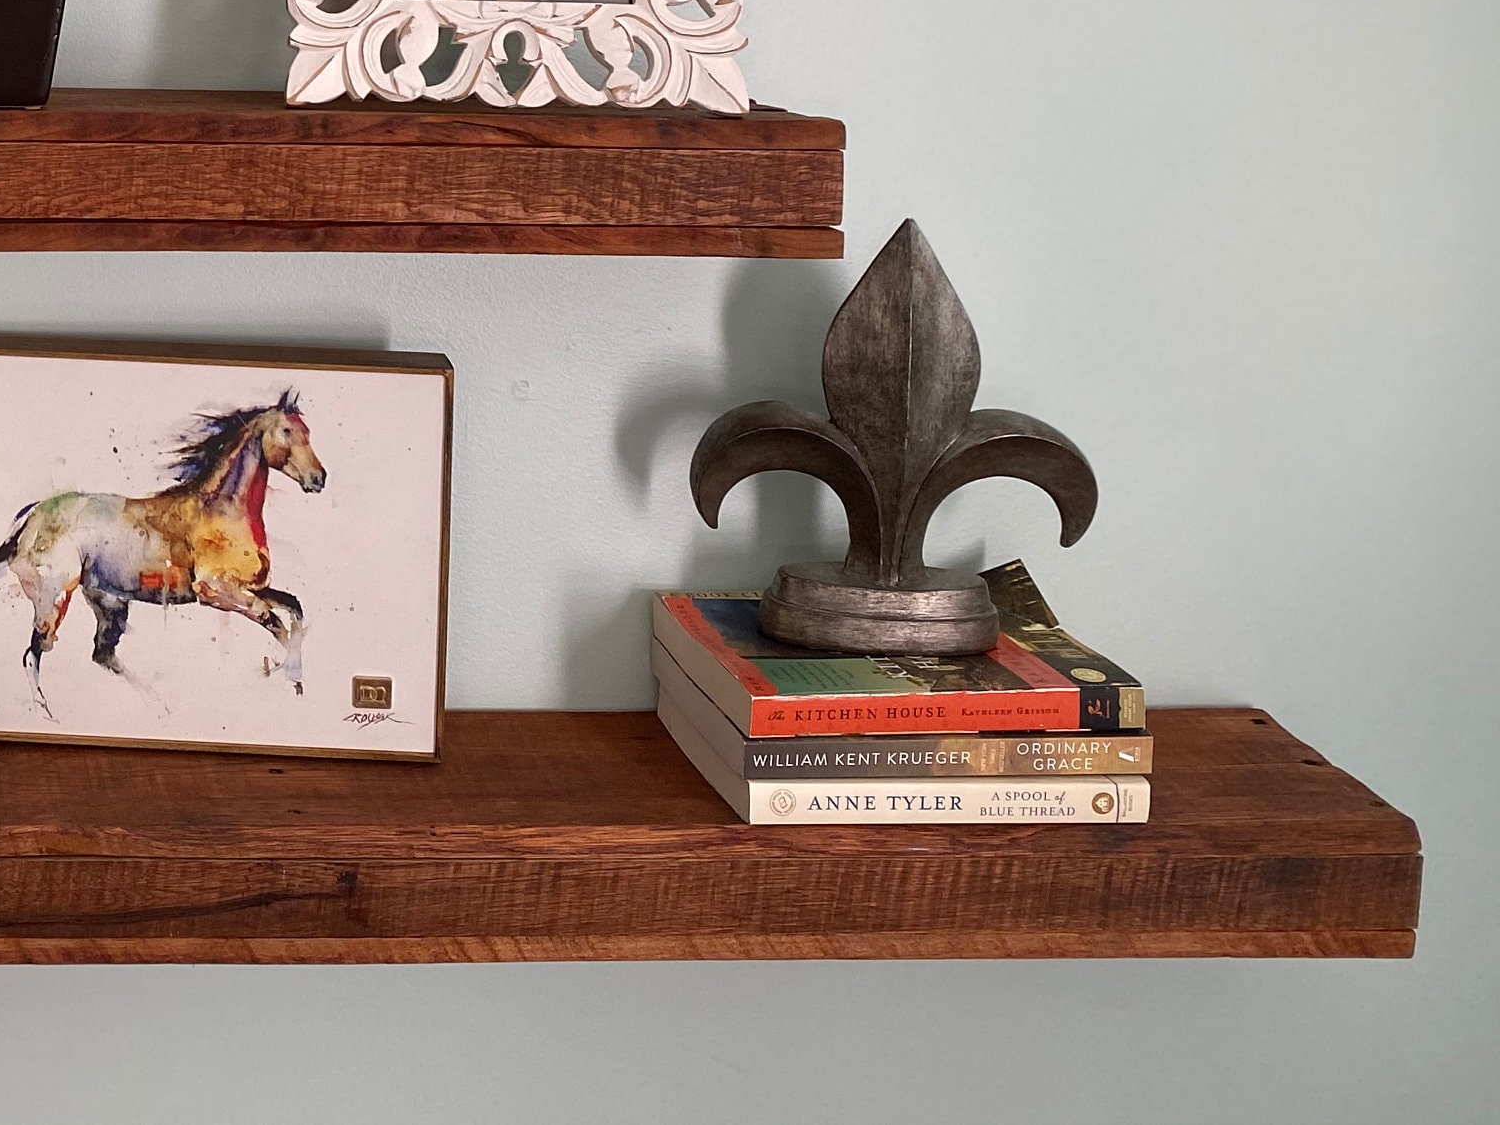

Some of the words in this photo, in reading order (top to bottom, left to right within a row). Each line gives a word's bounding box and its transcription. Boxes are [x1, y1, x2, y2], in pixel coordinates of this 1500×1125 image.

[767, 709, 786, 722] The
[794, 708, 878, 721] KITCHEN
[886, 706, 947, 719] HOUSE
[1016, 741, 1112, 756] ORDINARY
[752, 752, 829, 767] WILLIAM
[835, 751, 881, 766] KENT
[887, 750, 971, 766] KRUEGER
[1033, 757, 1094, 771] GRACE
[807, 795, 877, 811] ANNE
[886, 795, 963, 811] TYLER
[991, 791, 1001, 801] A
[1005, 791, 1051, 802] SPOOL
[1054, 791, 1067, 805] of
[980, 806, 1015, 817] BLUE
[1019, 806, 1076, 817] THREAD
